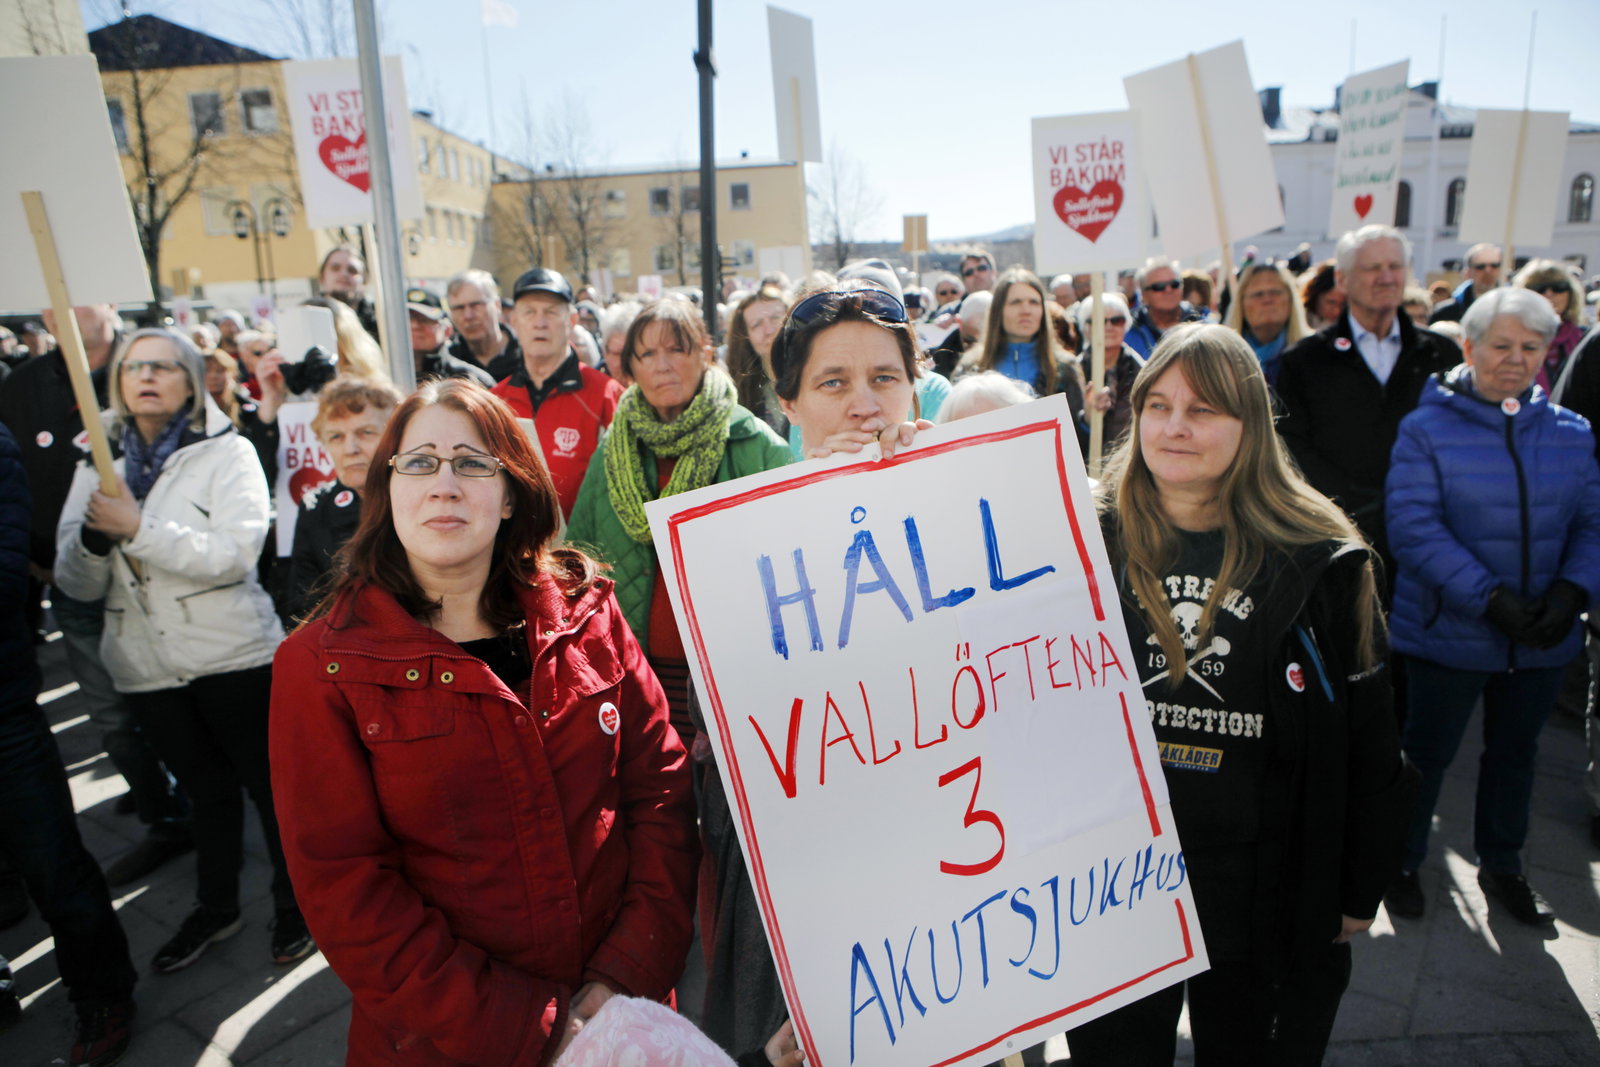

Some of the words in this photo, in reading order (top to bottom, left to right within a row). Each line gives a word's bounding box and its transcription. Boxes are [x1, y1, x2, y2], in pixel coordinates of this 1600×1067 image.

[308, 92, 330, 112] VI
[336, 88, 365, 111] ST
[311, 113, 366, 137] BAK
[1049, 145, 1068, 165] VI
[1075, 136, 1124, 163] STÅR
[1050, 163, 1126, 187] BAKOM
[286, 423, 305, 445] VI
[286, 446, 331, 470] BAK
[757, 497, 1056, 661] HÅLL
[1149, 653, 1166, 668] 19
[1202, 660, 1225, 676] 59
[748, 631, 1129, 800] VALLÖFTENA
[1146, 699, 1264, 739] OTECTION
[1158, 744, 1220, 766] ÅKLÄDER
[938, 755, 1006, 877] 3
[850, 844, 1187, 1065] AKUTSJUKHUS
